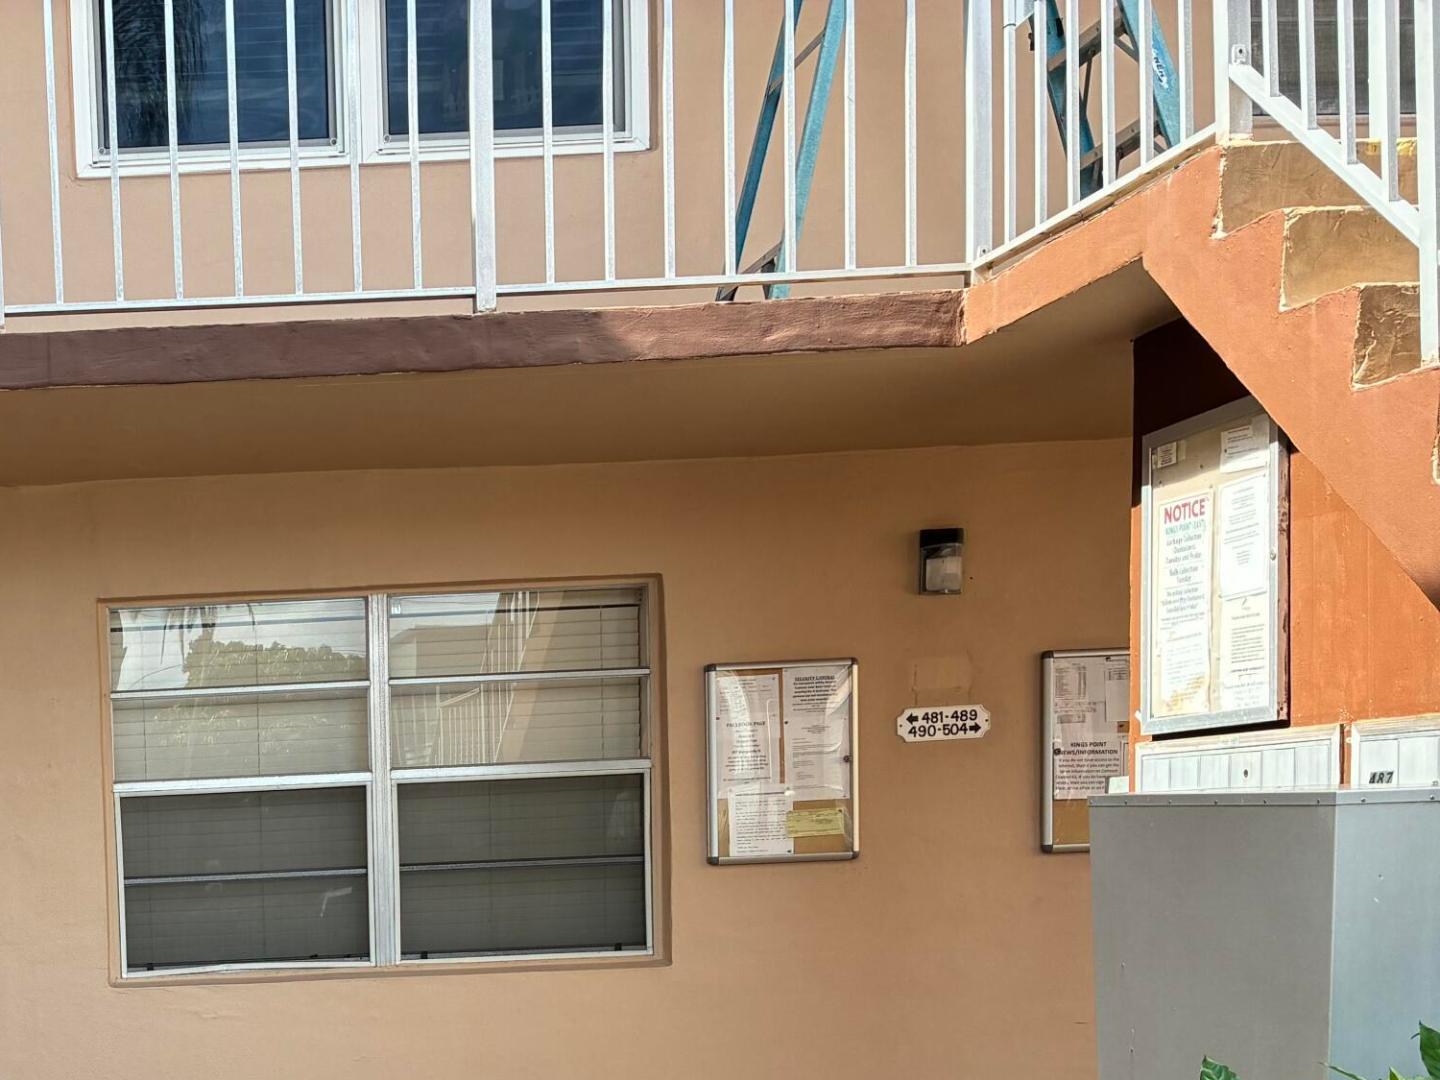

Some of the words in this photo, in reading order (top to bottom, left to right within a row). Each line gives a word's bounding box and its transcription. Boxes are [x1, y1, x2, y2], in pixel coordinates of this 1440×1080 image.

[1164, 498, 1206, 525] NOTICE
[921, 709, 978, 724] 481-489
[908, 723, 968, 738] 490-504
